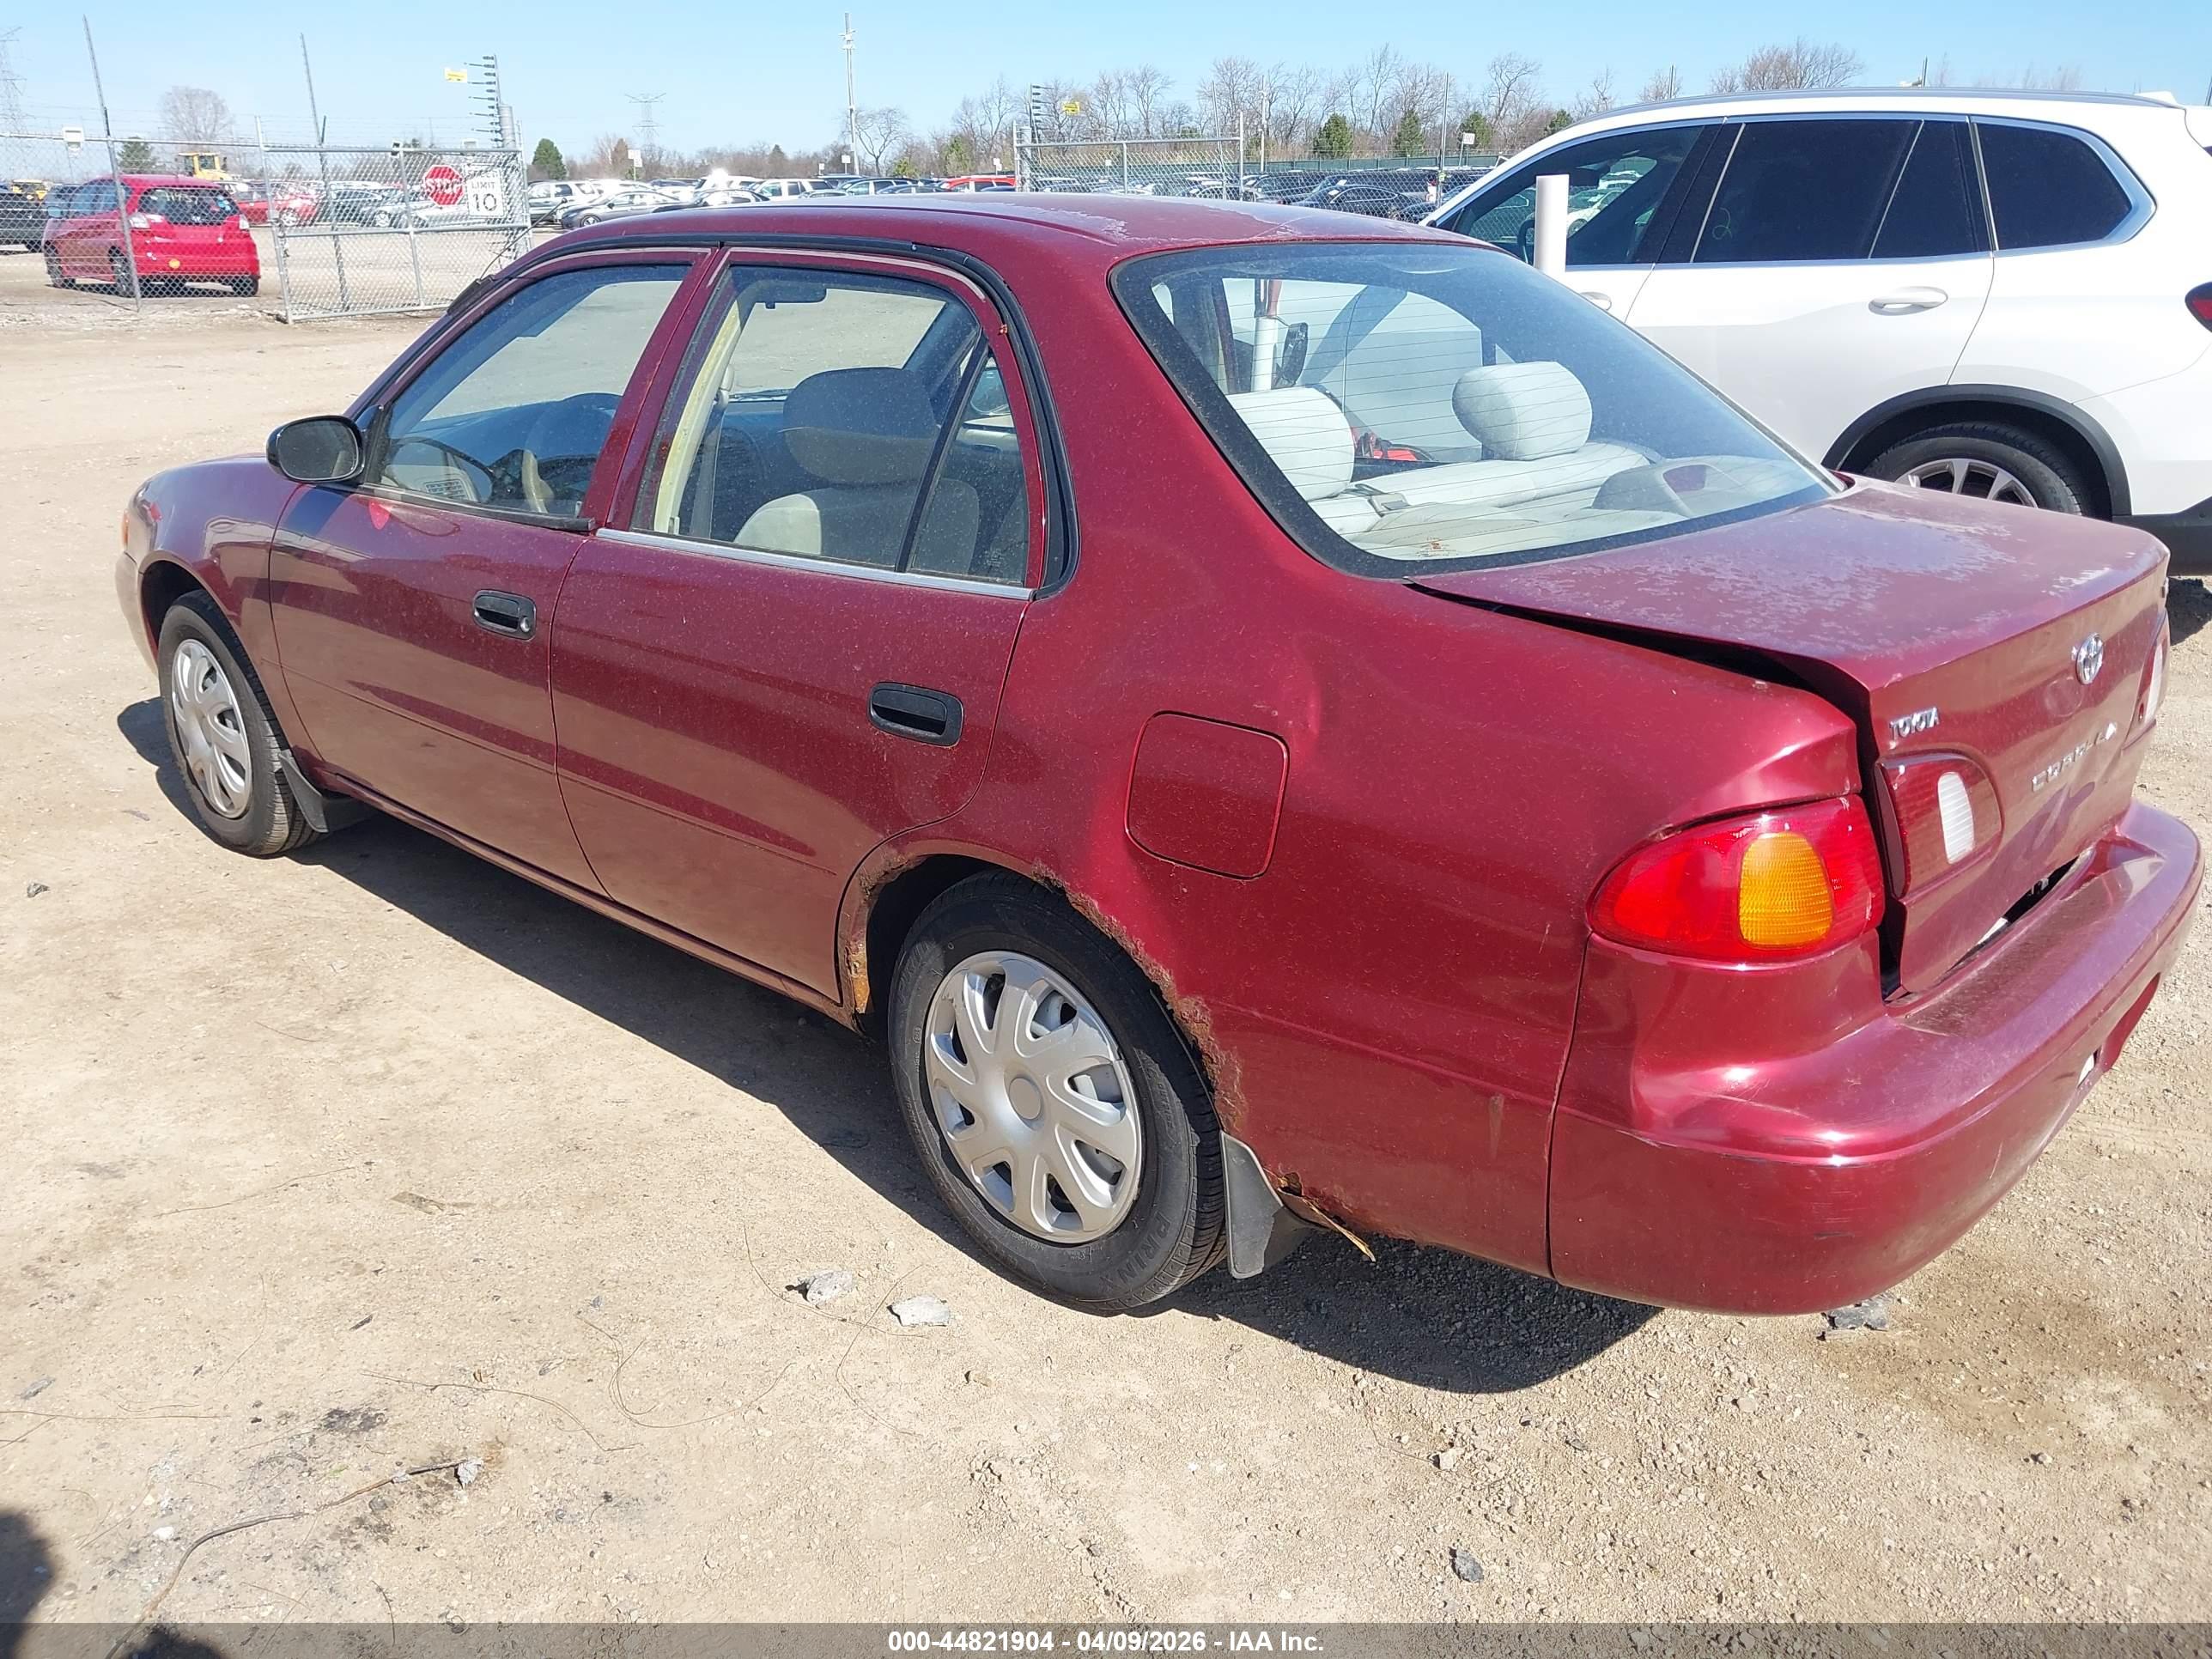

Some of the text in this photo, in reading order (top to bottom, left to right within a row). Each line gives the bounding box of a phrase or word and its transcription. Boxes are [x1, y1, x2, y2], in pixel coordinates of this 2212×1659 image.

[425, 178, 463, 194] STOP
[473, 193, 497, 212] 10
[1889, 707, 1939, 740] TOYOTA
[1099, 1209, 1171, 1292] PRINX
